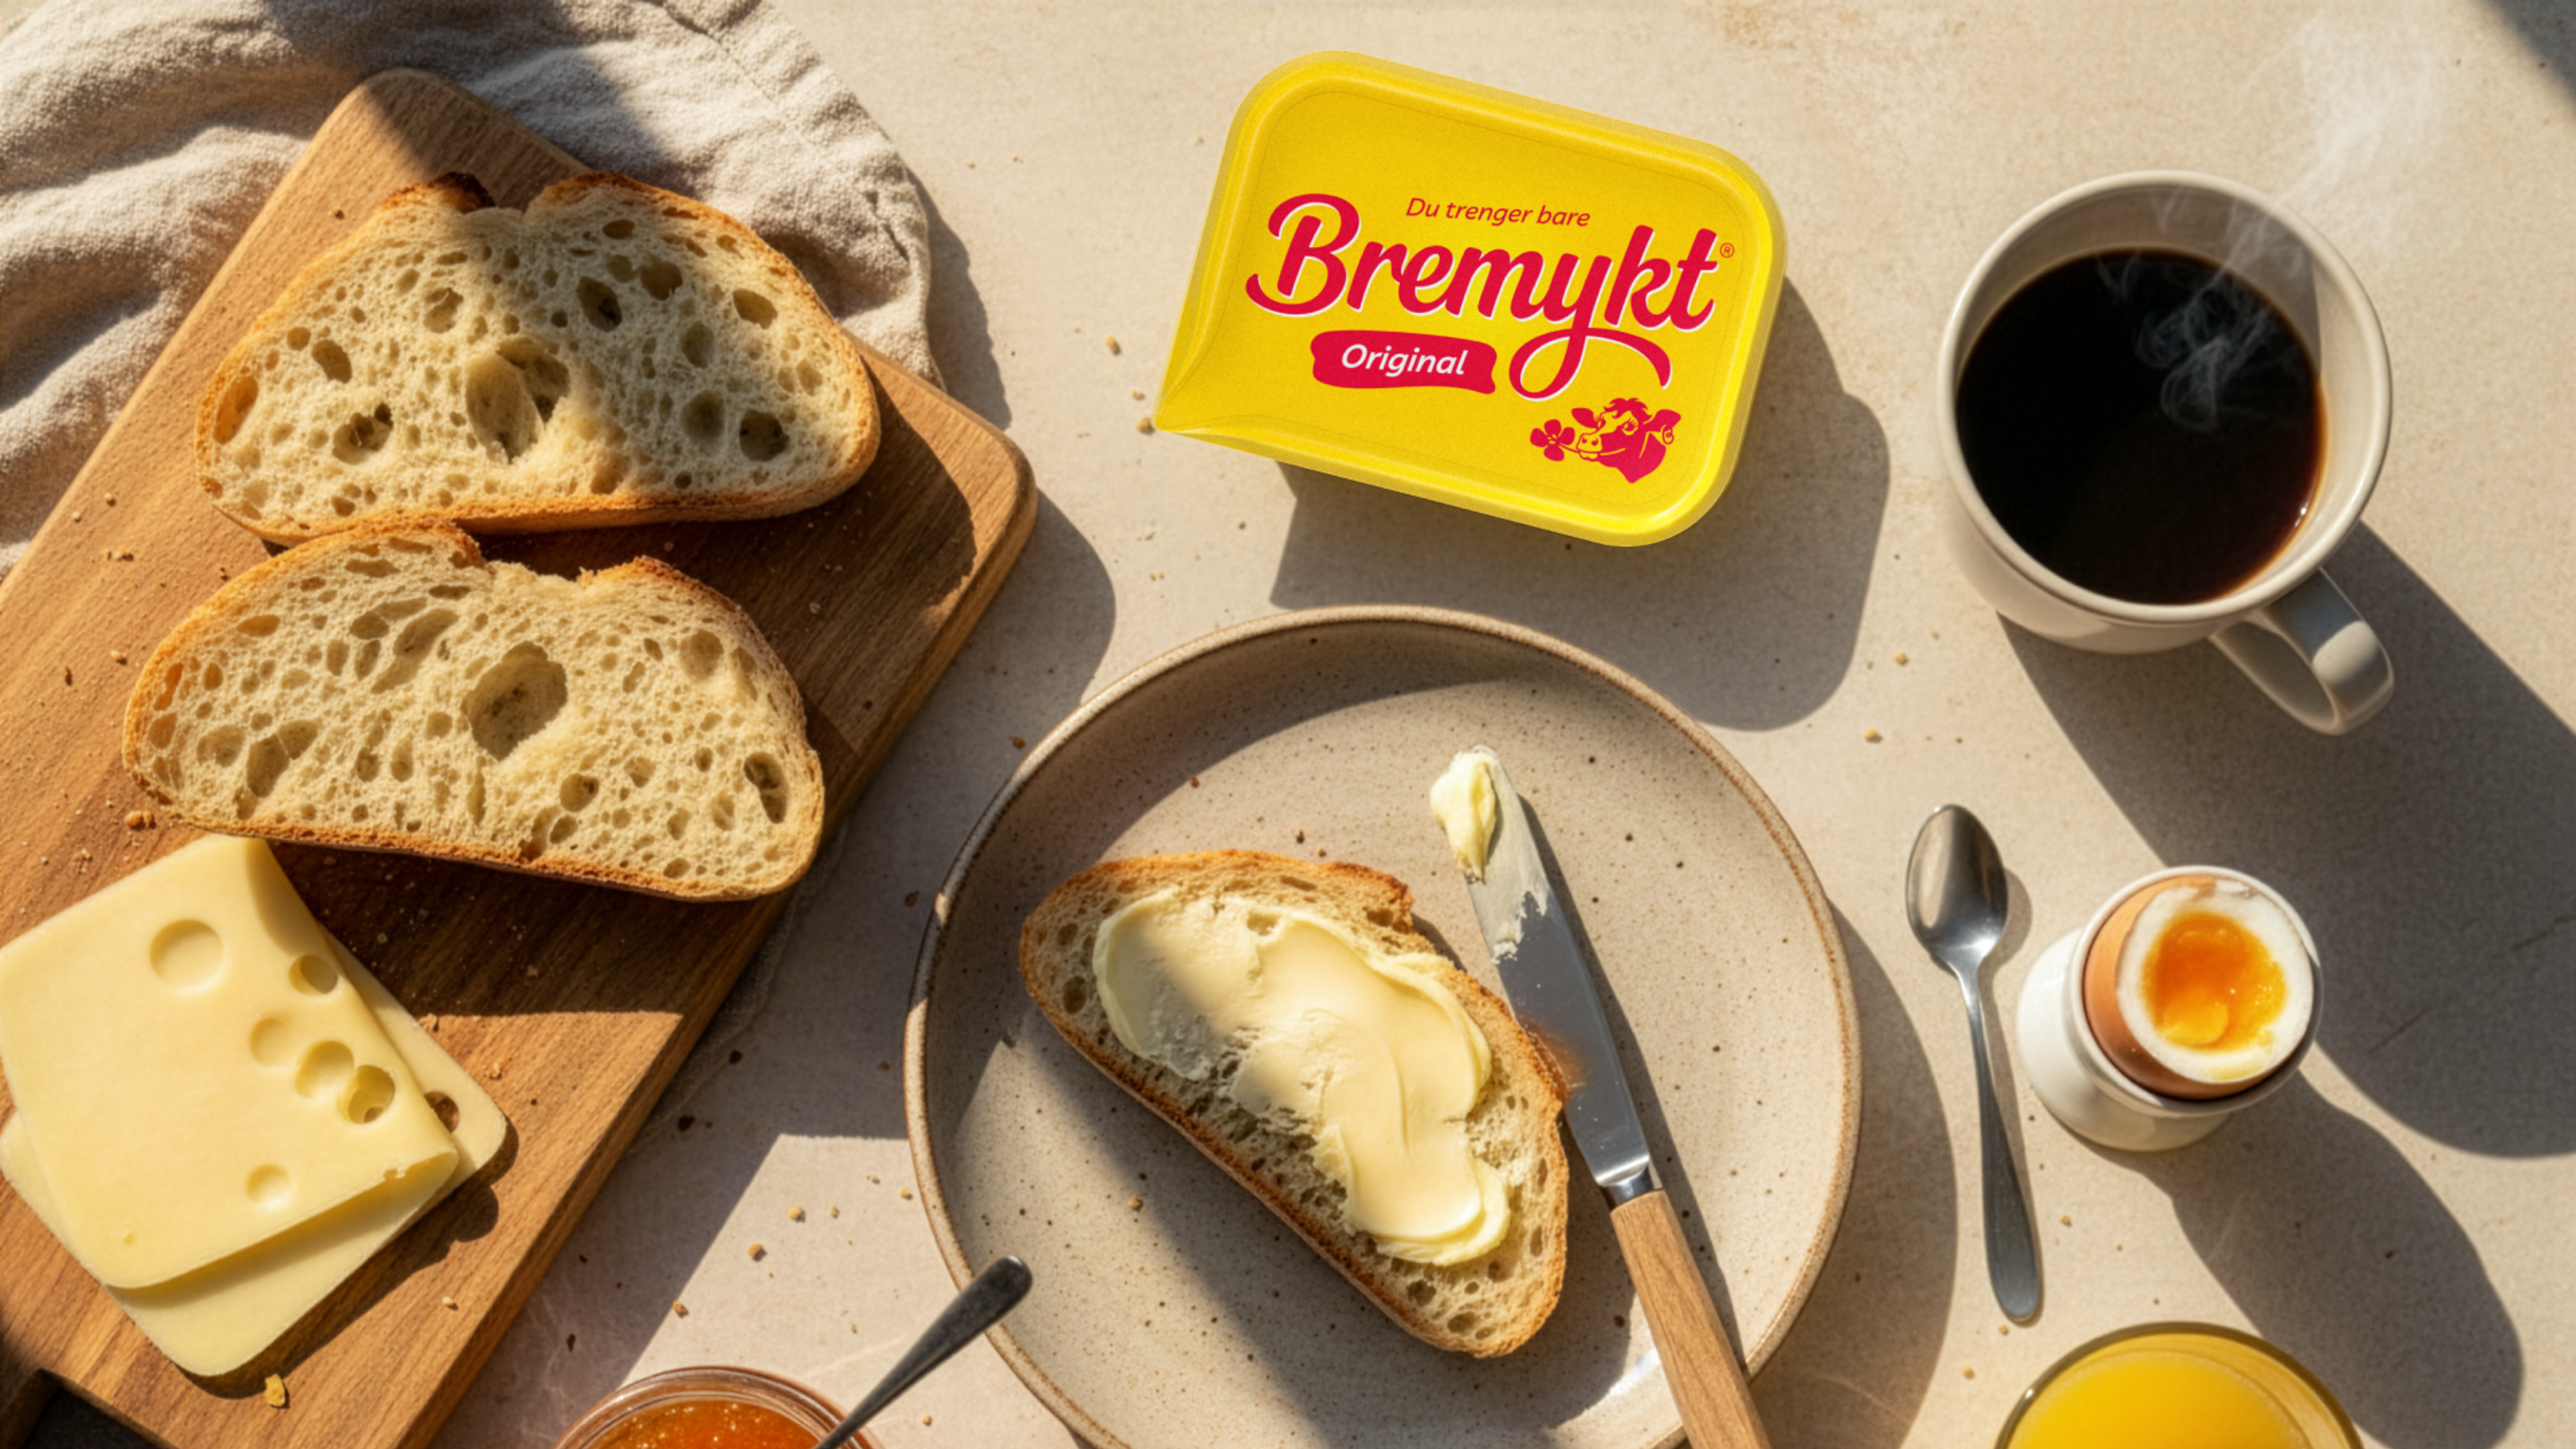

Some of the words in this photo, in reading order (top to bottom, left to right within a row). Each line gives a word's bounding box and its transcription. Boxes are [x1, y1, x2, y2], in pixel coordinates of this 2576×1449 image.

[1405, 197, 1441, 218] Du
[1446, 202, 1534, 227] trenger
[1536, 205, 1591, 227] bare
[1342, 343, 1468, 378] Original
